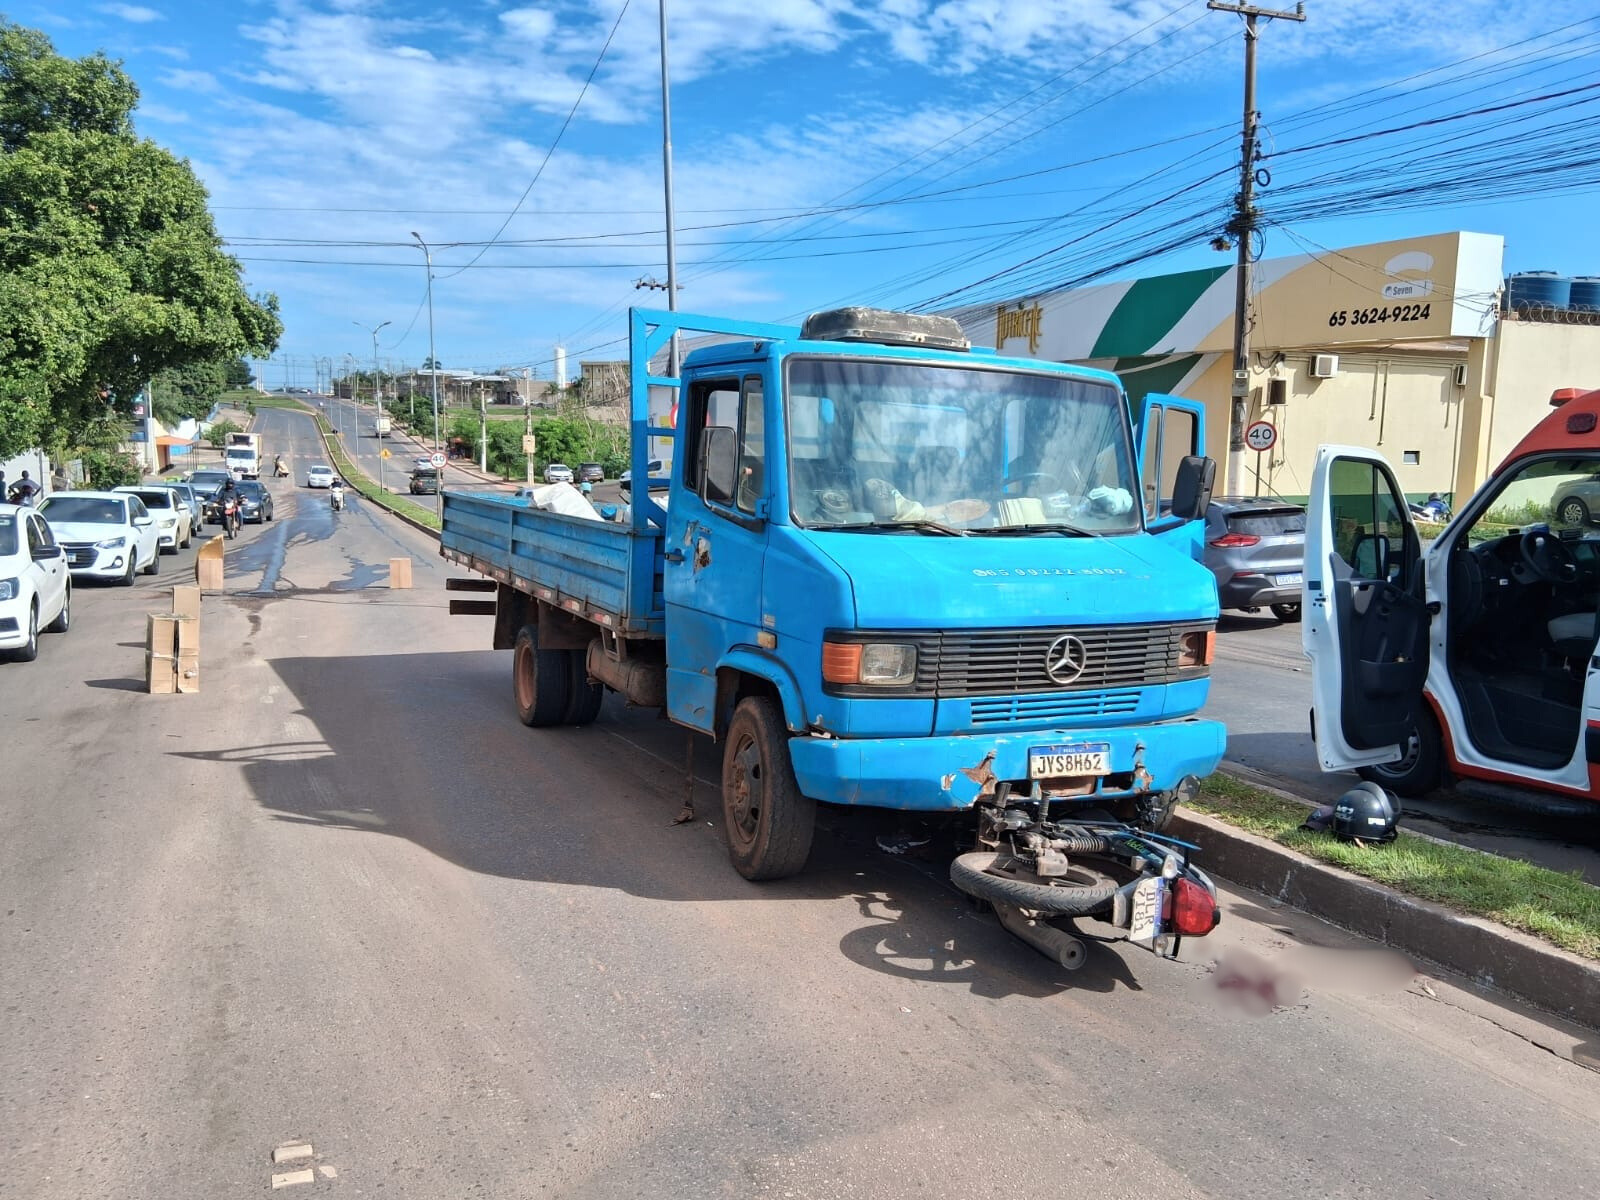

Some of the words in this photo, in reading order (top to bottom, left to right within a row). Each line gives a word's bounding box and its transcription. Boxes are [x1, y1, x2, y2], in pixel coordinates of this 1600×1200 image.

[1392, 286, 1413, 296] Seven
[1329, 310, 1347, 327] 65
[1351, 303, 1431, 325] 3624-9224
[1249, 428, 1272, 440] 40
[1037, 753, 1102, 774] JYS8H62
[1144, 892, 1156, 925] DLR
